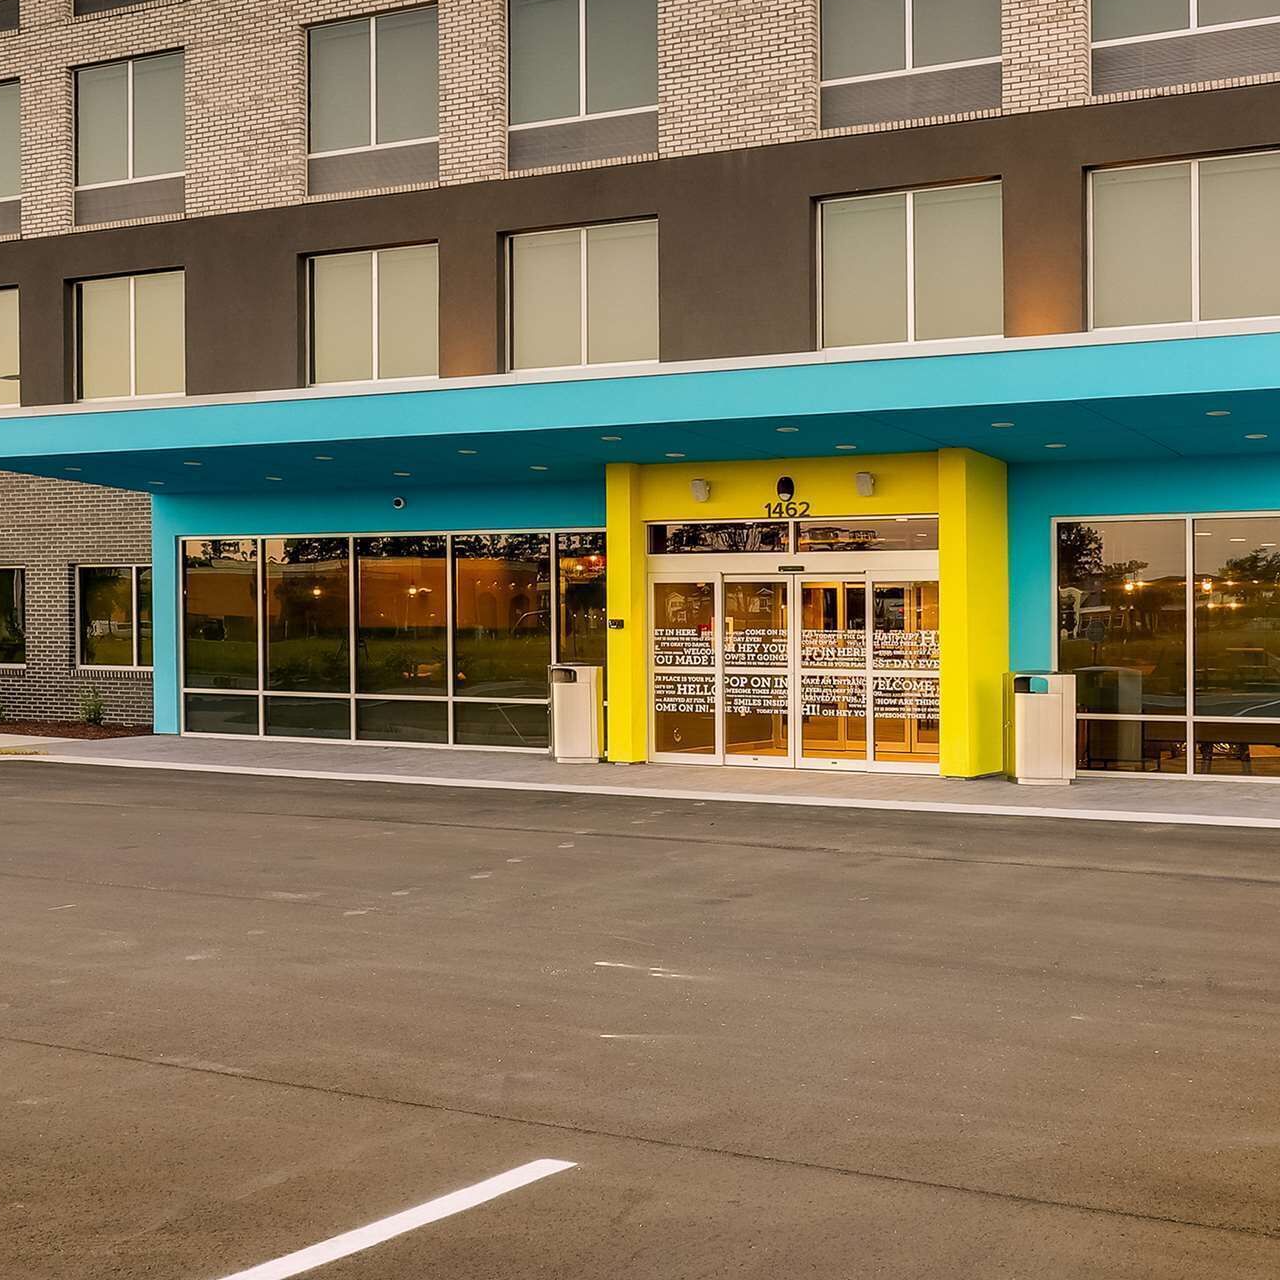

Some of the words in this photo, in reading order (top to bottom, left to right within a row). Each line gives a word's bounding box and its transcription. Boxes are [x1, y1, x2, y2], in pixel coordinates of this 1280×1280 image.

[764, 502, 810, 518] 1462
[738, 644, 760, 652] HEY
[654, 655, 673, 665] OU
[675, 655, 709, 665] MADE
[751, 677, 771, 688] ON
[656, 703, 677, 712] OME
[678, 703, 693, 712] ON
[695, 704, 709, 712] IN!
